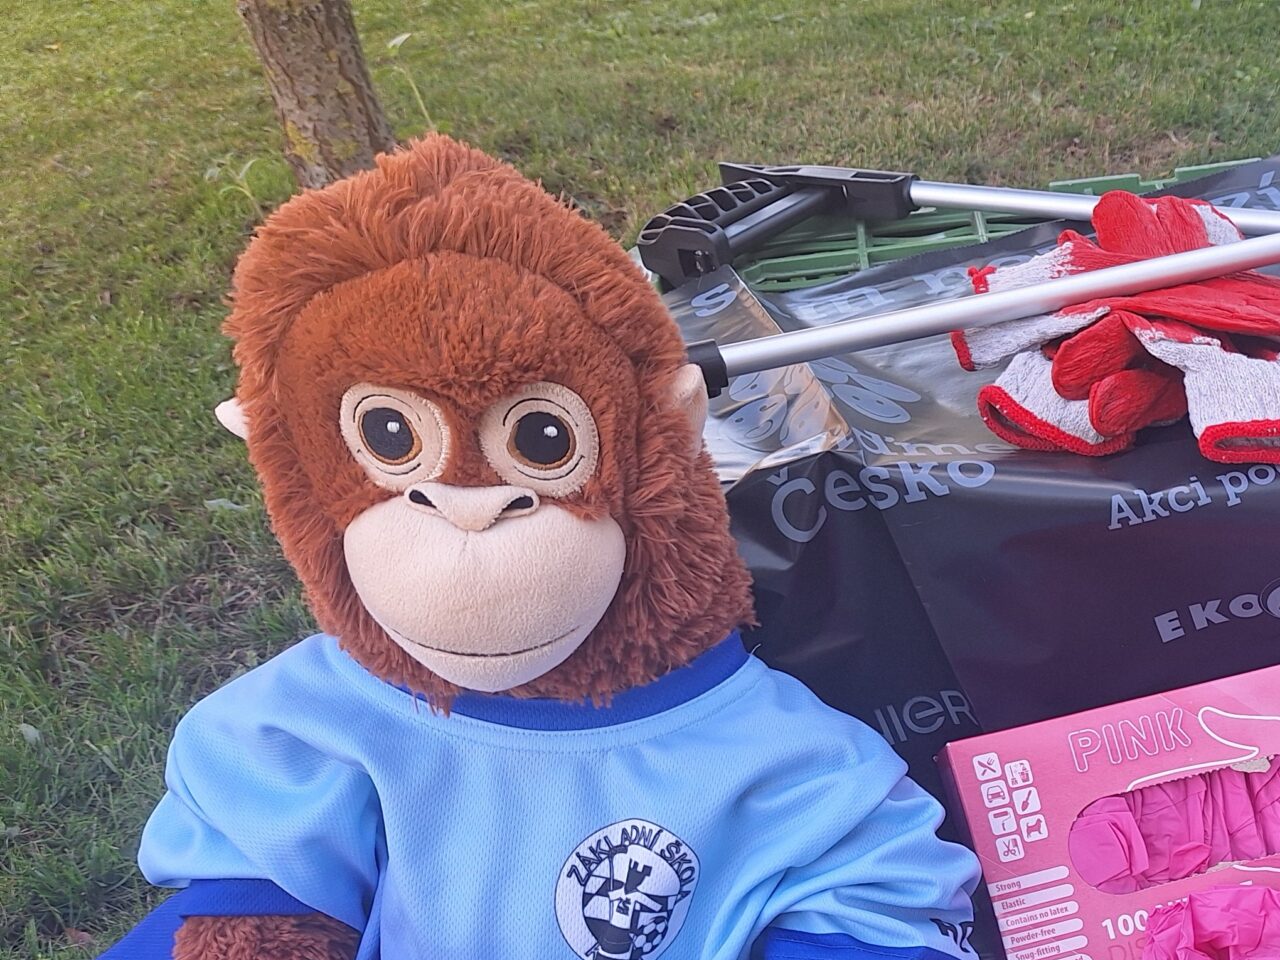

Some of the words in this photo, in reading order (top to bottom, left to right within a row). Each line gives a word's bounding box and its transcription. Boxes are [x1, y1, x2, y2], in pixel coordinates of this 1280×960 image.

[766, 460, 996, 543] Česko
[1107, 474, 1212, 531] Akci
[1067, 707, 1192, 773] PINK
[995, 880, 1022, 893] Strong
[1001, 898, 1026, 910] Elastic
[1005, 912, 1039, 927] Contains
[1039, 911, 1049, 919] no
[1049, 905, 1069, 917] latex
[1010, 927, 1057, 945] Powder-free
[1101, 909, 1149, 940] 100
